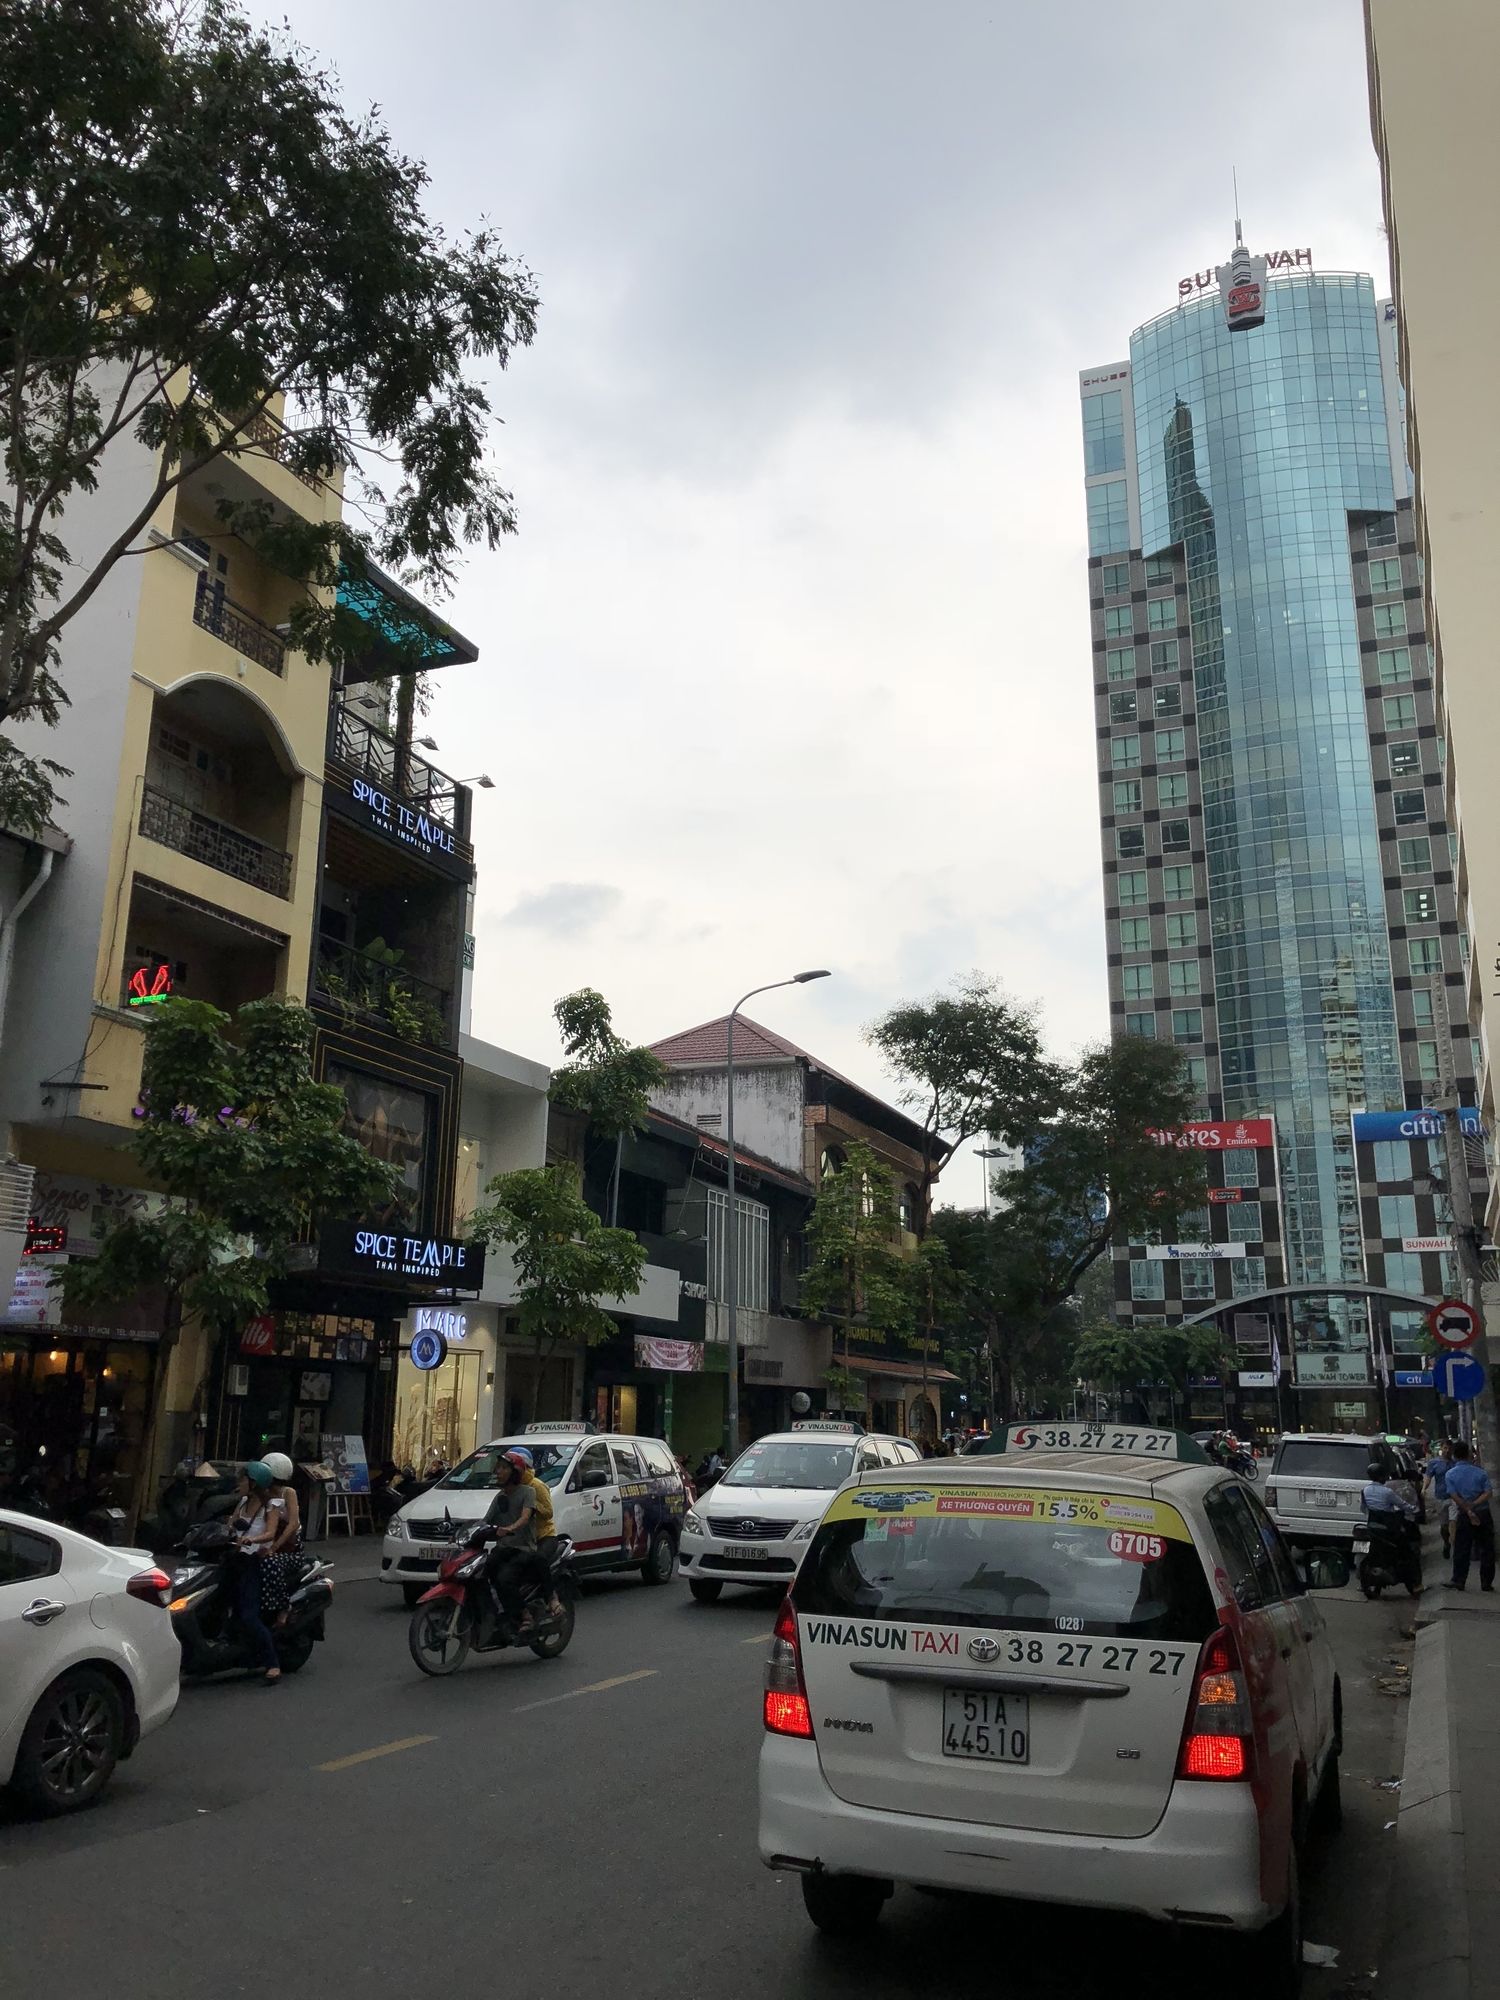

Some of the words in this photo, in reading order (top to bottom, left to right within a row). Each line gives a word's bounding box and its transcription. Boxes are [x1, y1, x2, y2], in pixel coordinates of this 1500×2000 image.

[1178, 268, 1220, 296] SU
[1083, 371, 1127, 387] CHUBB
[352, 779, 392, 817] SPICE
[397, 803, 455, 854] TEMPLE
[371, 814, 393, 832] THAI
[397, 827, 431, 854] INSPIRED
[1226, 1137, 1258, 1147] Emirates
[355, 1231, 396, 1258] SPICE
[403, 1239, 466, 1268] TEMPLE
[1406, 1240, 1447, 1250] SUNWAH
[376, 1260, 397, 1272] THAI
[402, 1264, 440, 1277] INSPIRED
[416, 1309, 467, 1338] MARC
[242, 1322, 268, 1351] illy
[1300, 1373, 1317, 1381] SUN
[1319, 1373, 1337, 1381] WAH
[1339, 1373, 1367, 1381] TOWER
[1406, 1375, 1422, 1384] citi
[1084, 1423, 1106, 1433] (028)
[1111, 1433, 1139, 1449] 27
[1145, 1435, 1172, 1451] 27
[941, 1501, 953, 1509] XE
[1038, 1502, 1099, 1521] 15.5%
[1110, 1532, 1162, 1558] 6705
[1054, 1616, 1085, 1632] (028)
[807, 1622, 908, 1651] VINASUN
[911, 1630, 960, 1655] TAXI
[1007, 1639, 1044, 1664] 38
[1056, 1642, 1093, 1667] 27
[1102, 1646, 1139, 1671] 27
[1149, 1650, 1186, 1676] 27
[964, 1692, 1007, 1725] 51A
[823, 1717, 874, 1734] INNOVA
[946, 1723, 1026, 1759] 445.10
